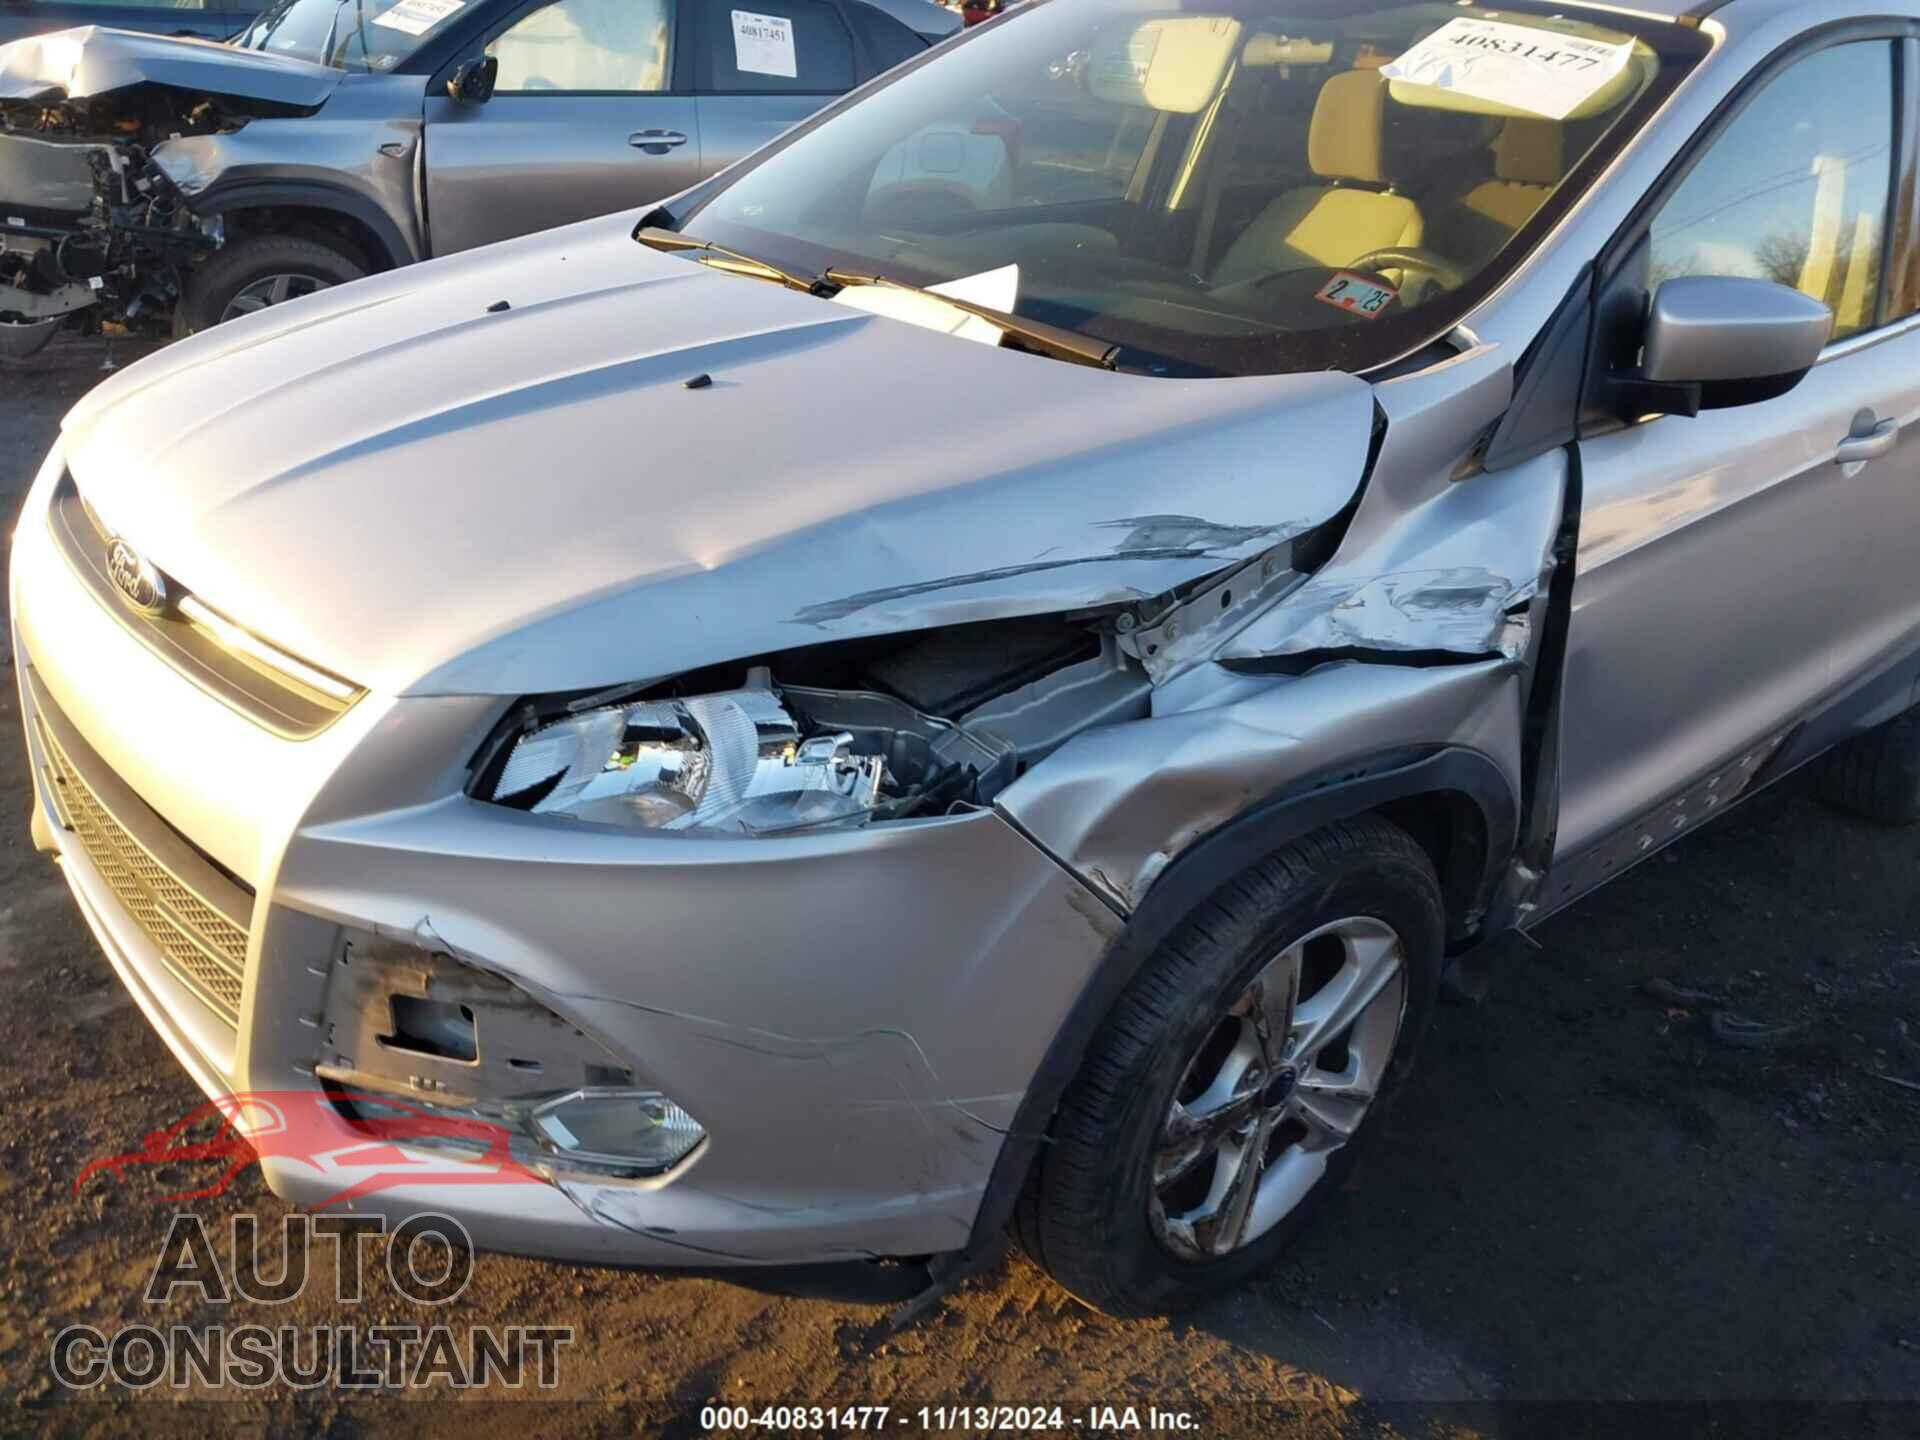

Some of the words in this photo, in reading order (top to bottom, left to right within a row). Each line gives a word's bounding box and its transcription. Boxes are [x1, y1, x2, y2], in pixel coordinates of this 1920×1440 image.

[1449, 33, 1600, 71] 40831477
[1326, 279, 1349, 300] 2
[110, 543, 142, 598] Ford
